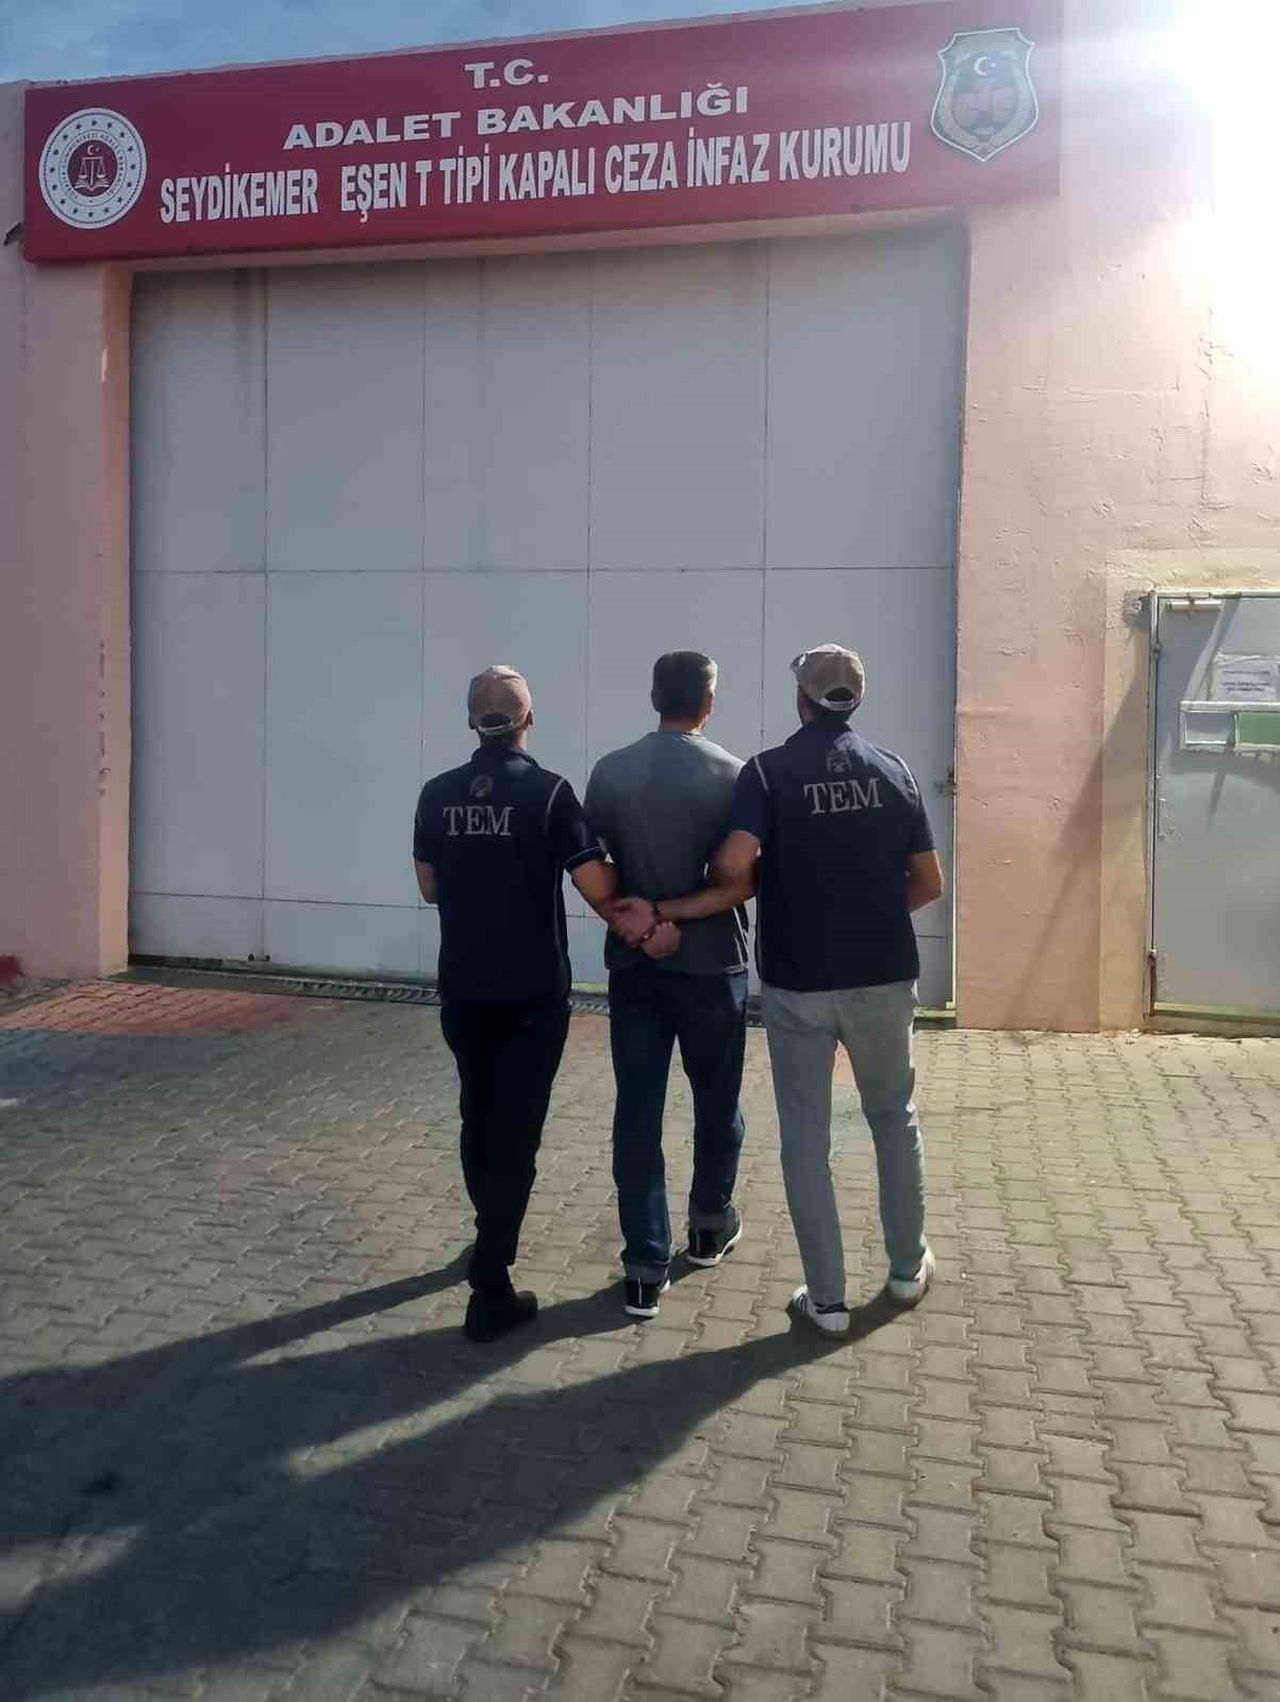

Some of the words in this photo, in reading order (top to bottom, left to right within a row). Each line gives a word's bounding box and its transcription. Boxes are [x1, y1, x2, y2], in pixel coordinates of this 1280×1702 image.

[465, 58, 548, 88] T.C.
[283, 112, 460, 149] ADALET
[477, 83, 748, 135] BAKANLIĞI
[161, 163, 318, 223] SEYDİKEMER
[341, 162, 406, 223] EŞEN
[415, 160, 432, 206] T
[440, 144, 490, 203] TİPİ
[499, 148, 595, 201] KAPALI
[605, 141, 678, 193] CEZA
[687, 127, 770, 187] İNFAZ
[779, 122, 911, 180] KURUMU
[803, 778, 883, 814] TEM
[443, 806, 514, 836] TEM
